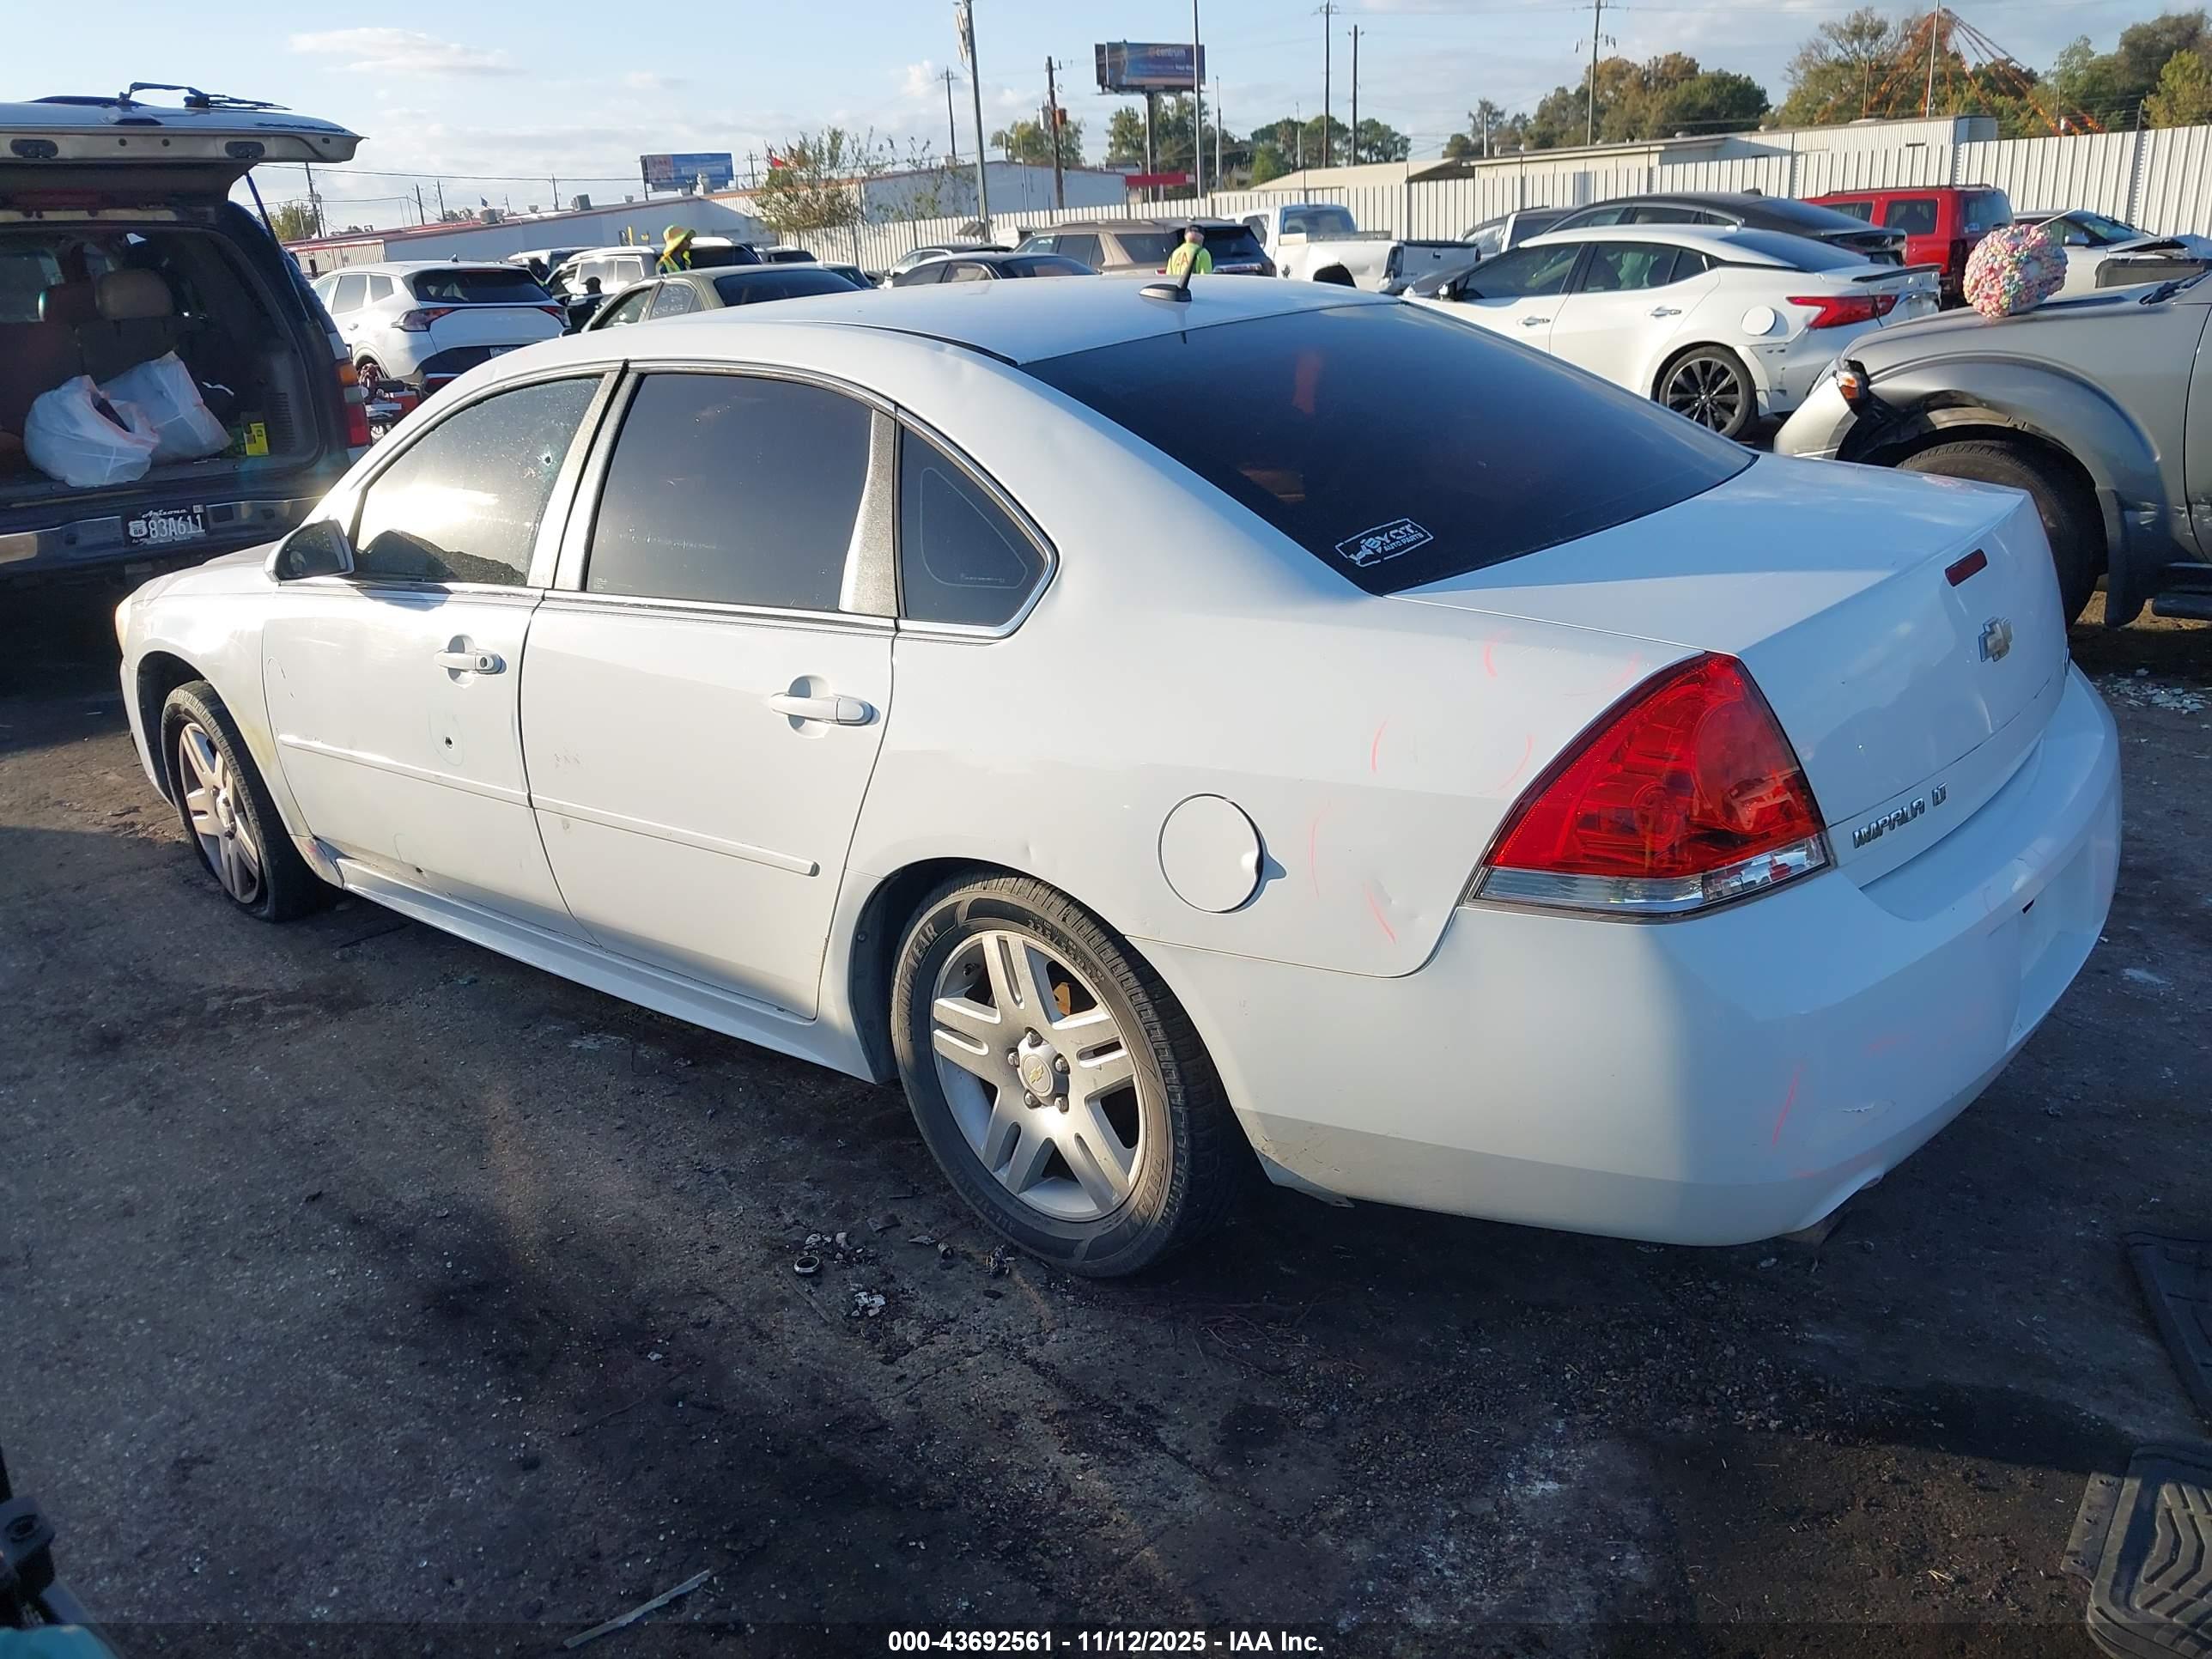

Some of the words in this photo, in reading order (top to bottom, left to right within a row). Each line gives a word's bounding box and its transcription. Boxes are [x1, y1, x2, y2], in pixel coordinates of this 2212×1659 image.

[148, 514, 206, 538] 83A611
[1853, 798, 1925, 848] IMPALA
[1931, 782, 1948, 806] LT
